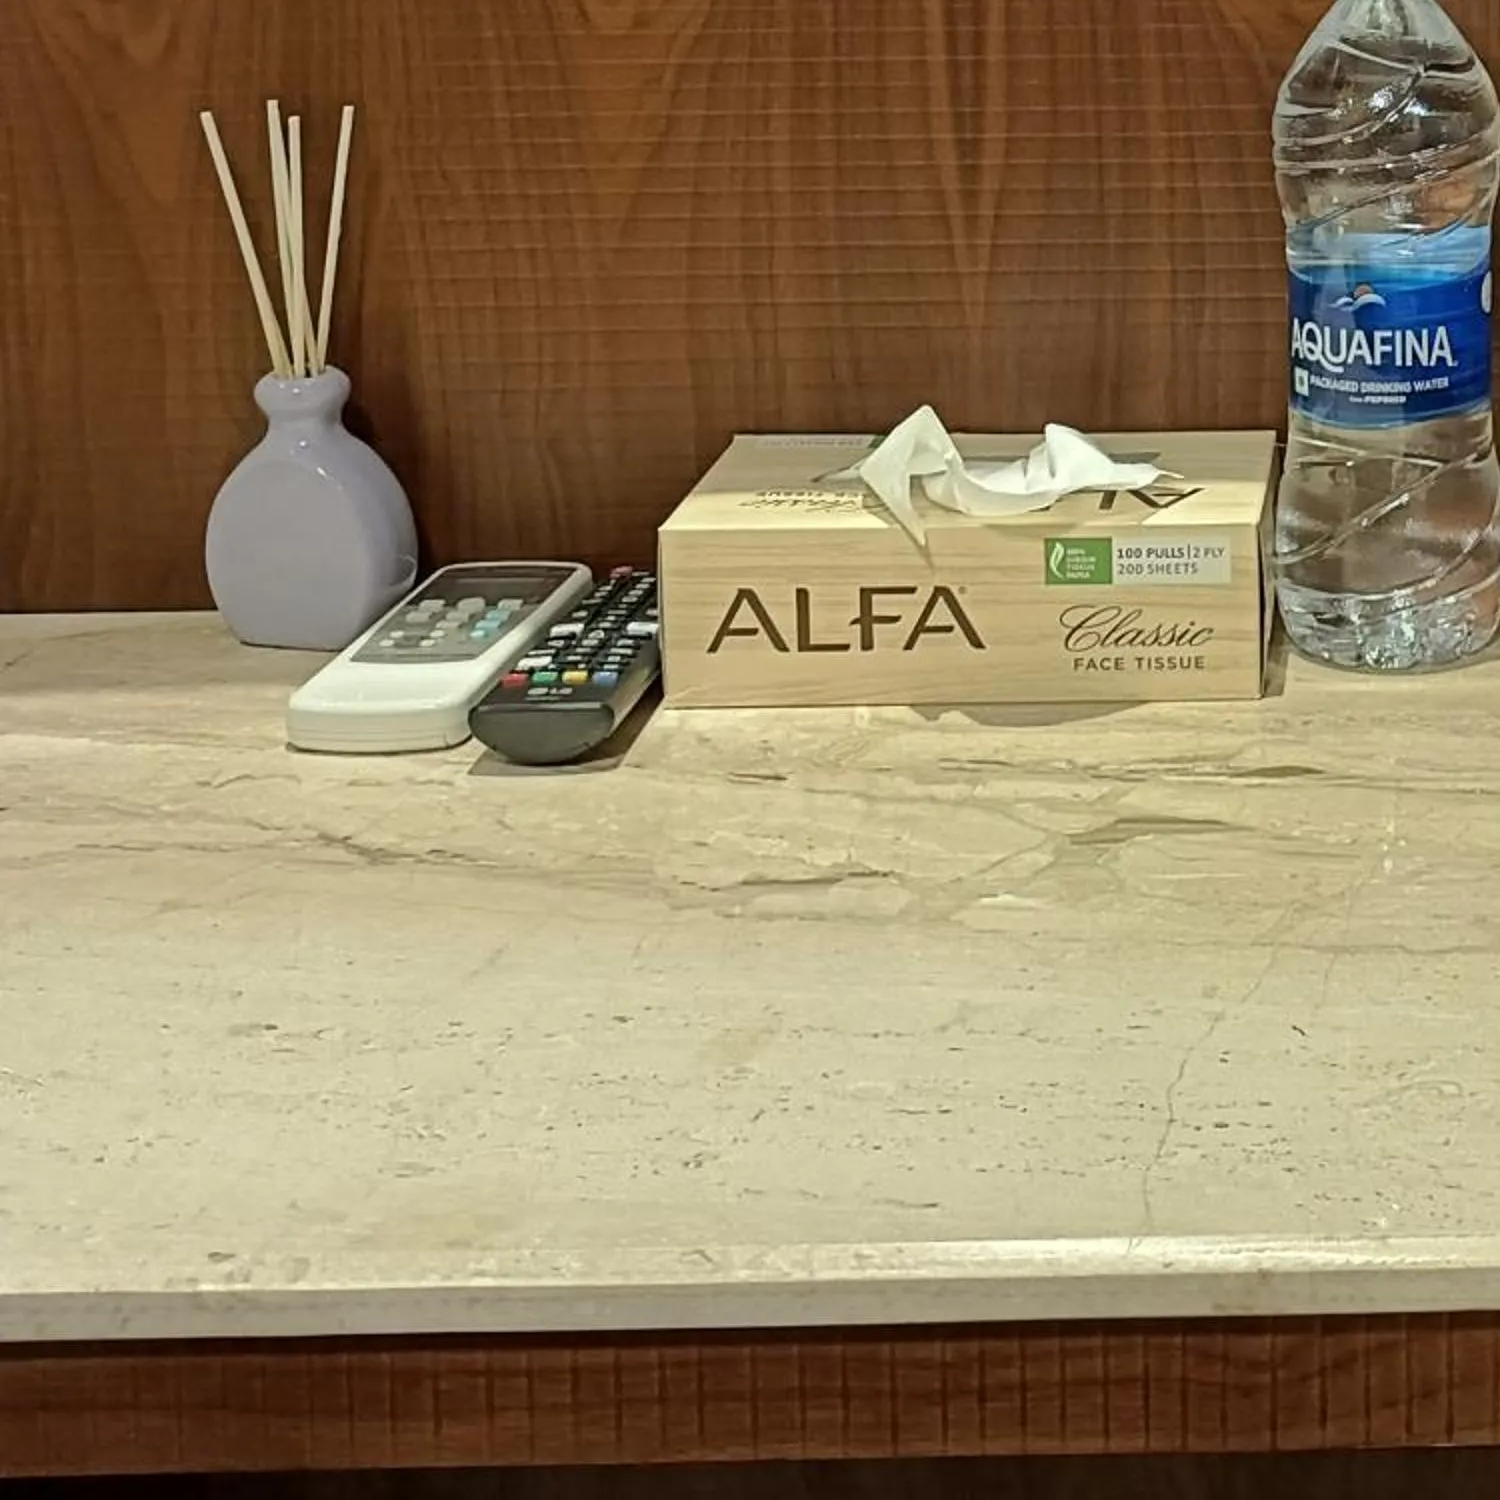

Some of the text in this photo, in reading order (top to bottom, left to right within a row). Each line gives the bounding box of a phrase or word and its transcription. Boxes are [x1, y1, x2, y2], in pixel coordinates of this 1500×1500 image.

[1291, 318, 1453, 373] AQUAFINA
[1413, 376, 1449, 392] WATER
[1117, 547, 1142, 559] 100
[1147, 562, 1198, 575] SHEETS
[706, 585, 987, 654] ALFA
[1059, 604, 1214, 652] Classic
[1073, 656, 1205, 671] FACE TISSUE
